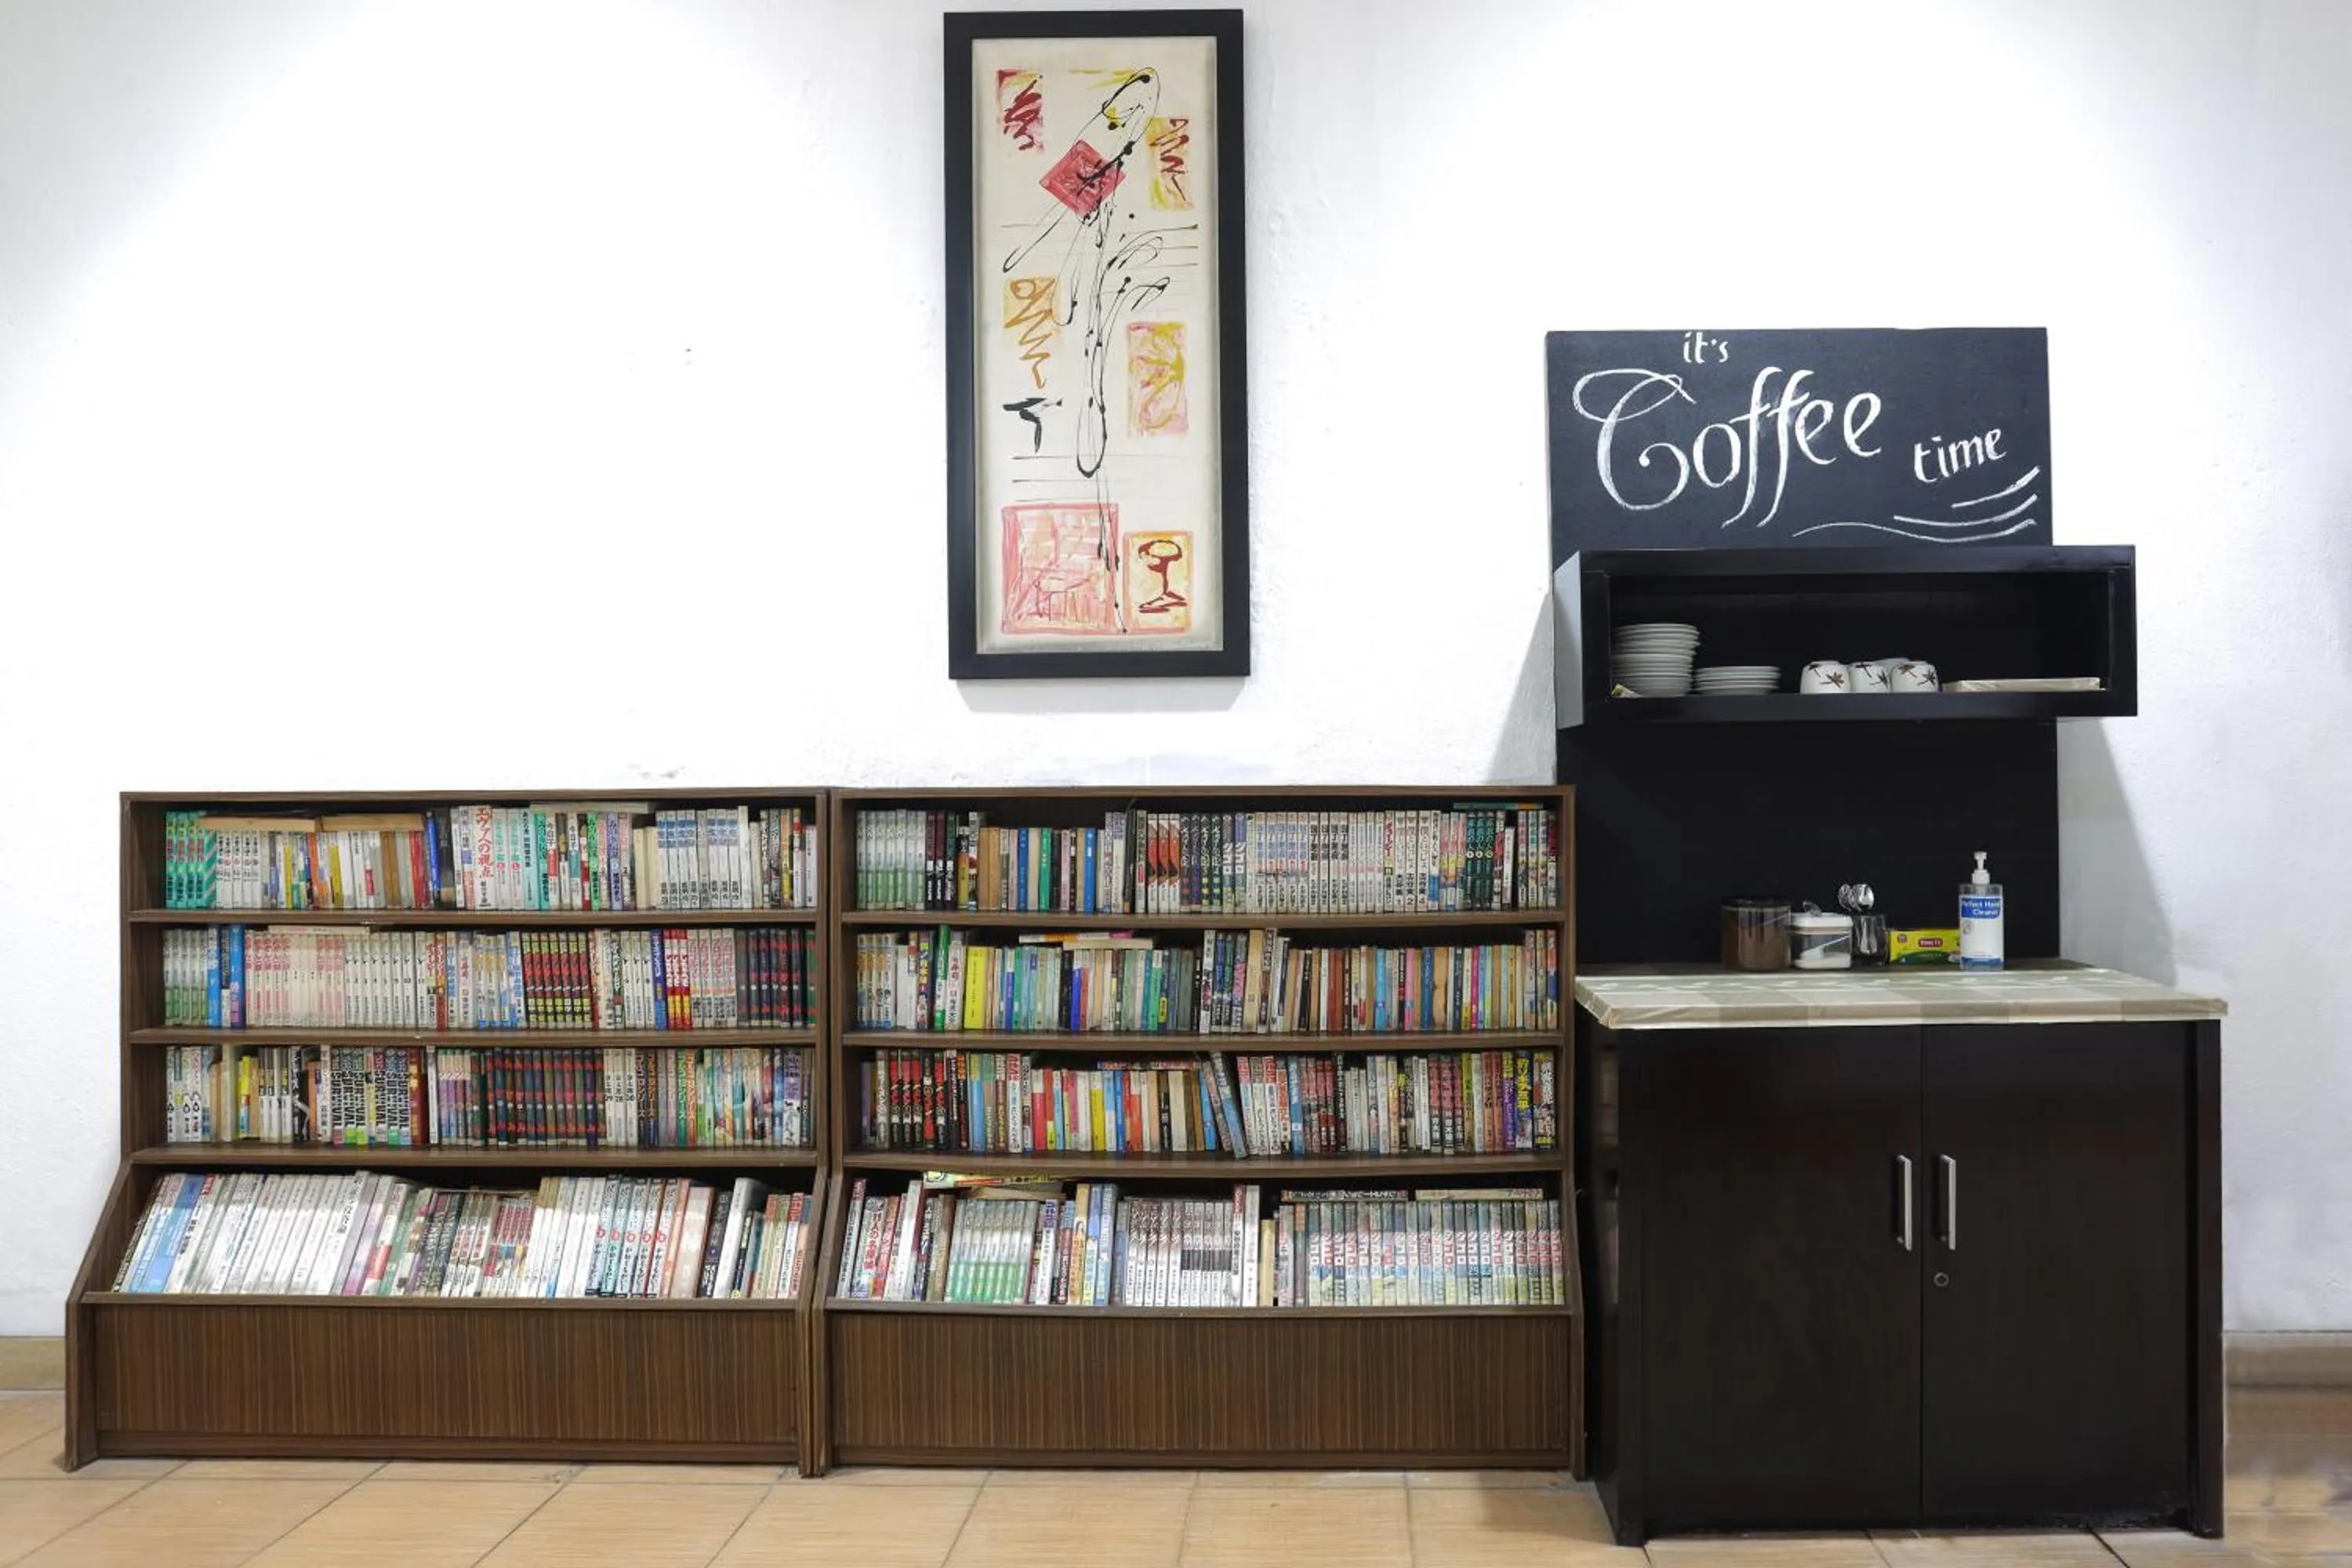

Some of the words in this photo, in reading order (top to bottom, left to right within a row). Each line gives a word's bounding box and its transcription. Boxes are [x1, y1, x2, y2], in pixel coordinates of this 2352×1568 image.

[1682, 331, 1730, 363] it's
[1573, 366, 1882, 528] Coffee
[1913, 427, 2007, 483] time
